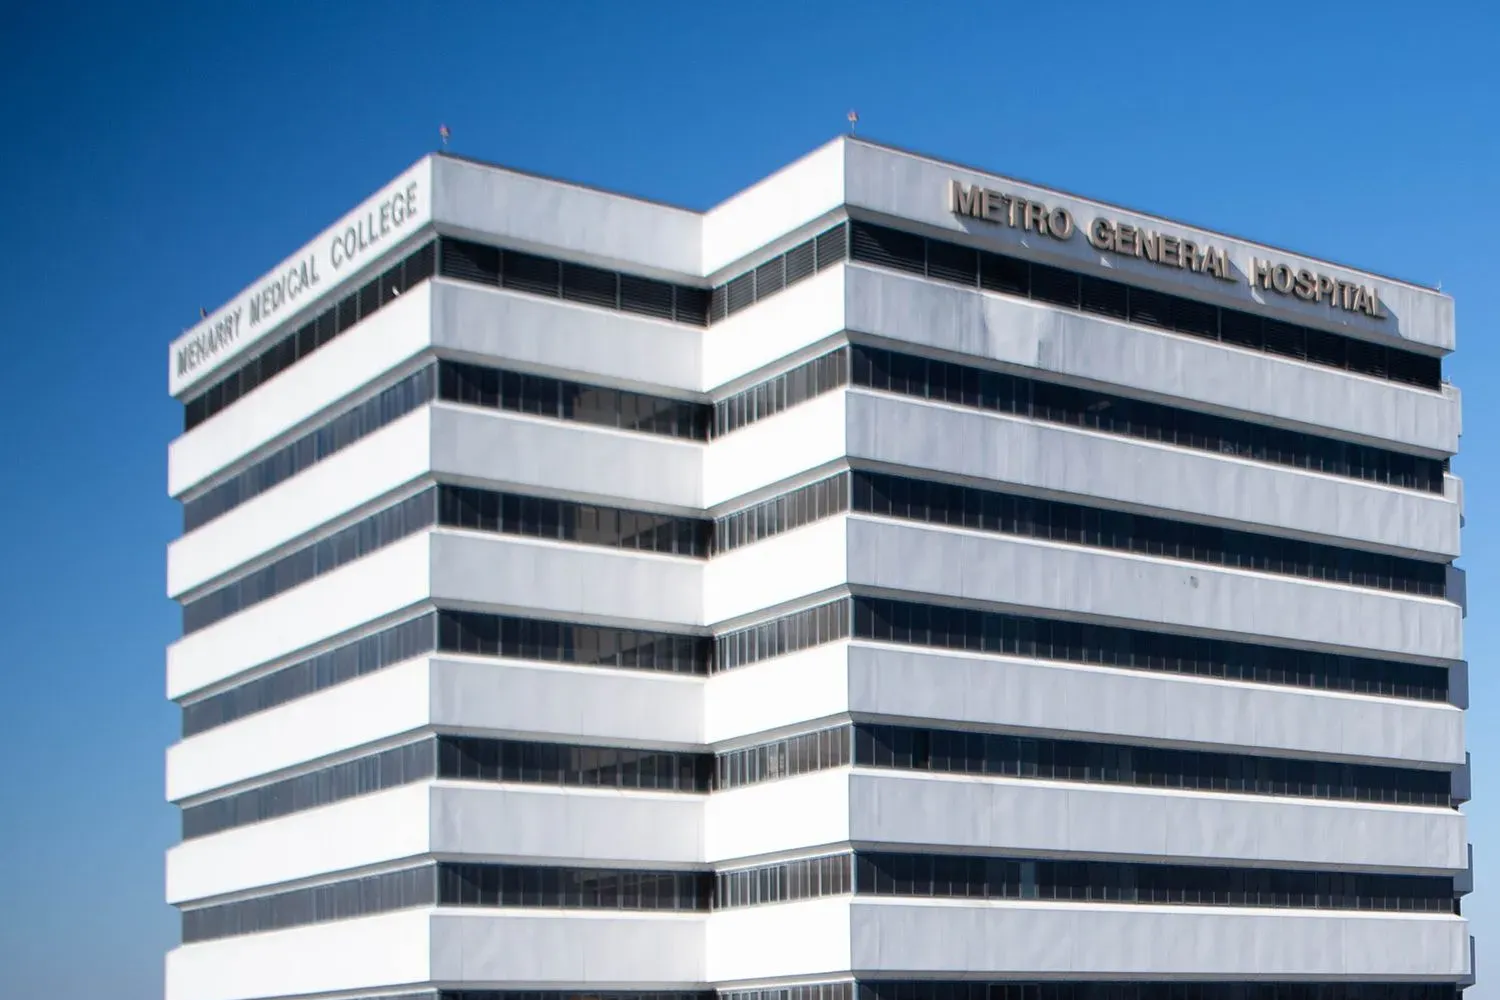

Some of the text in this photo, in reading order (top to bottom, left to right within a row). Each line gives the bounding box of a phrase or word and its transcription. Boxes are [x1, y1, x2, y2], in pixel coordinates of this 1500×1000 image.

[177, 181, 418, 376] MEHARRY MEDICAL COLLEGE
[948, 179, 1388, 319] METRO GENERAL HOSPITAL
